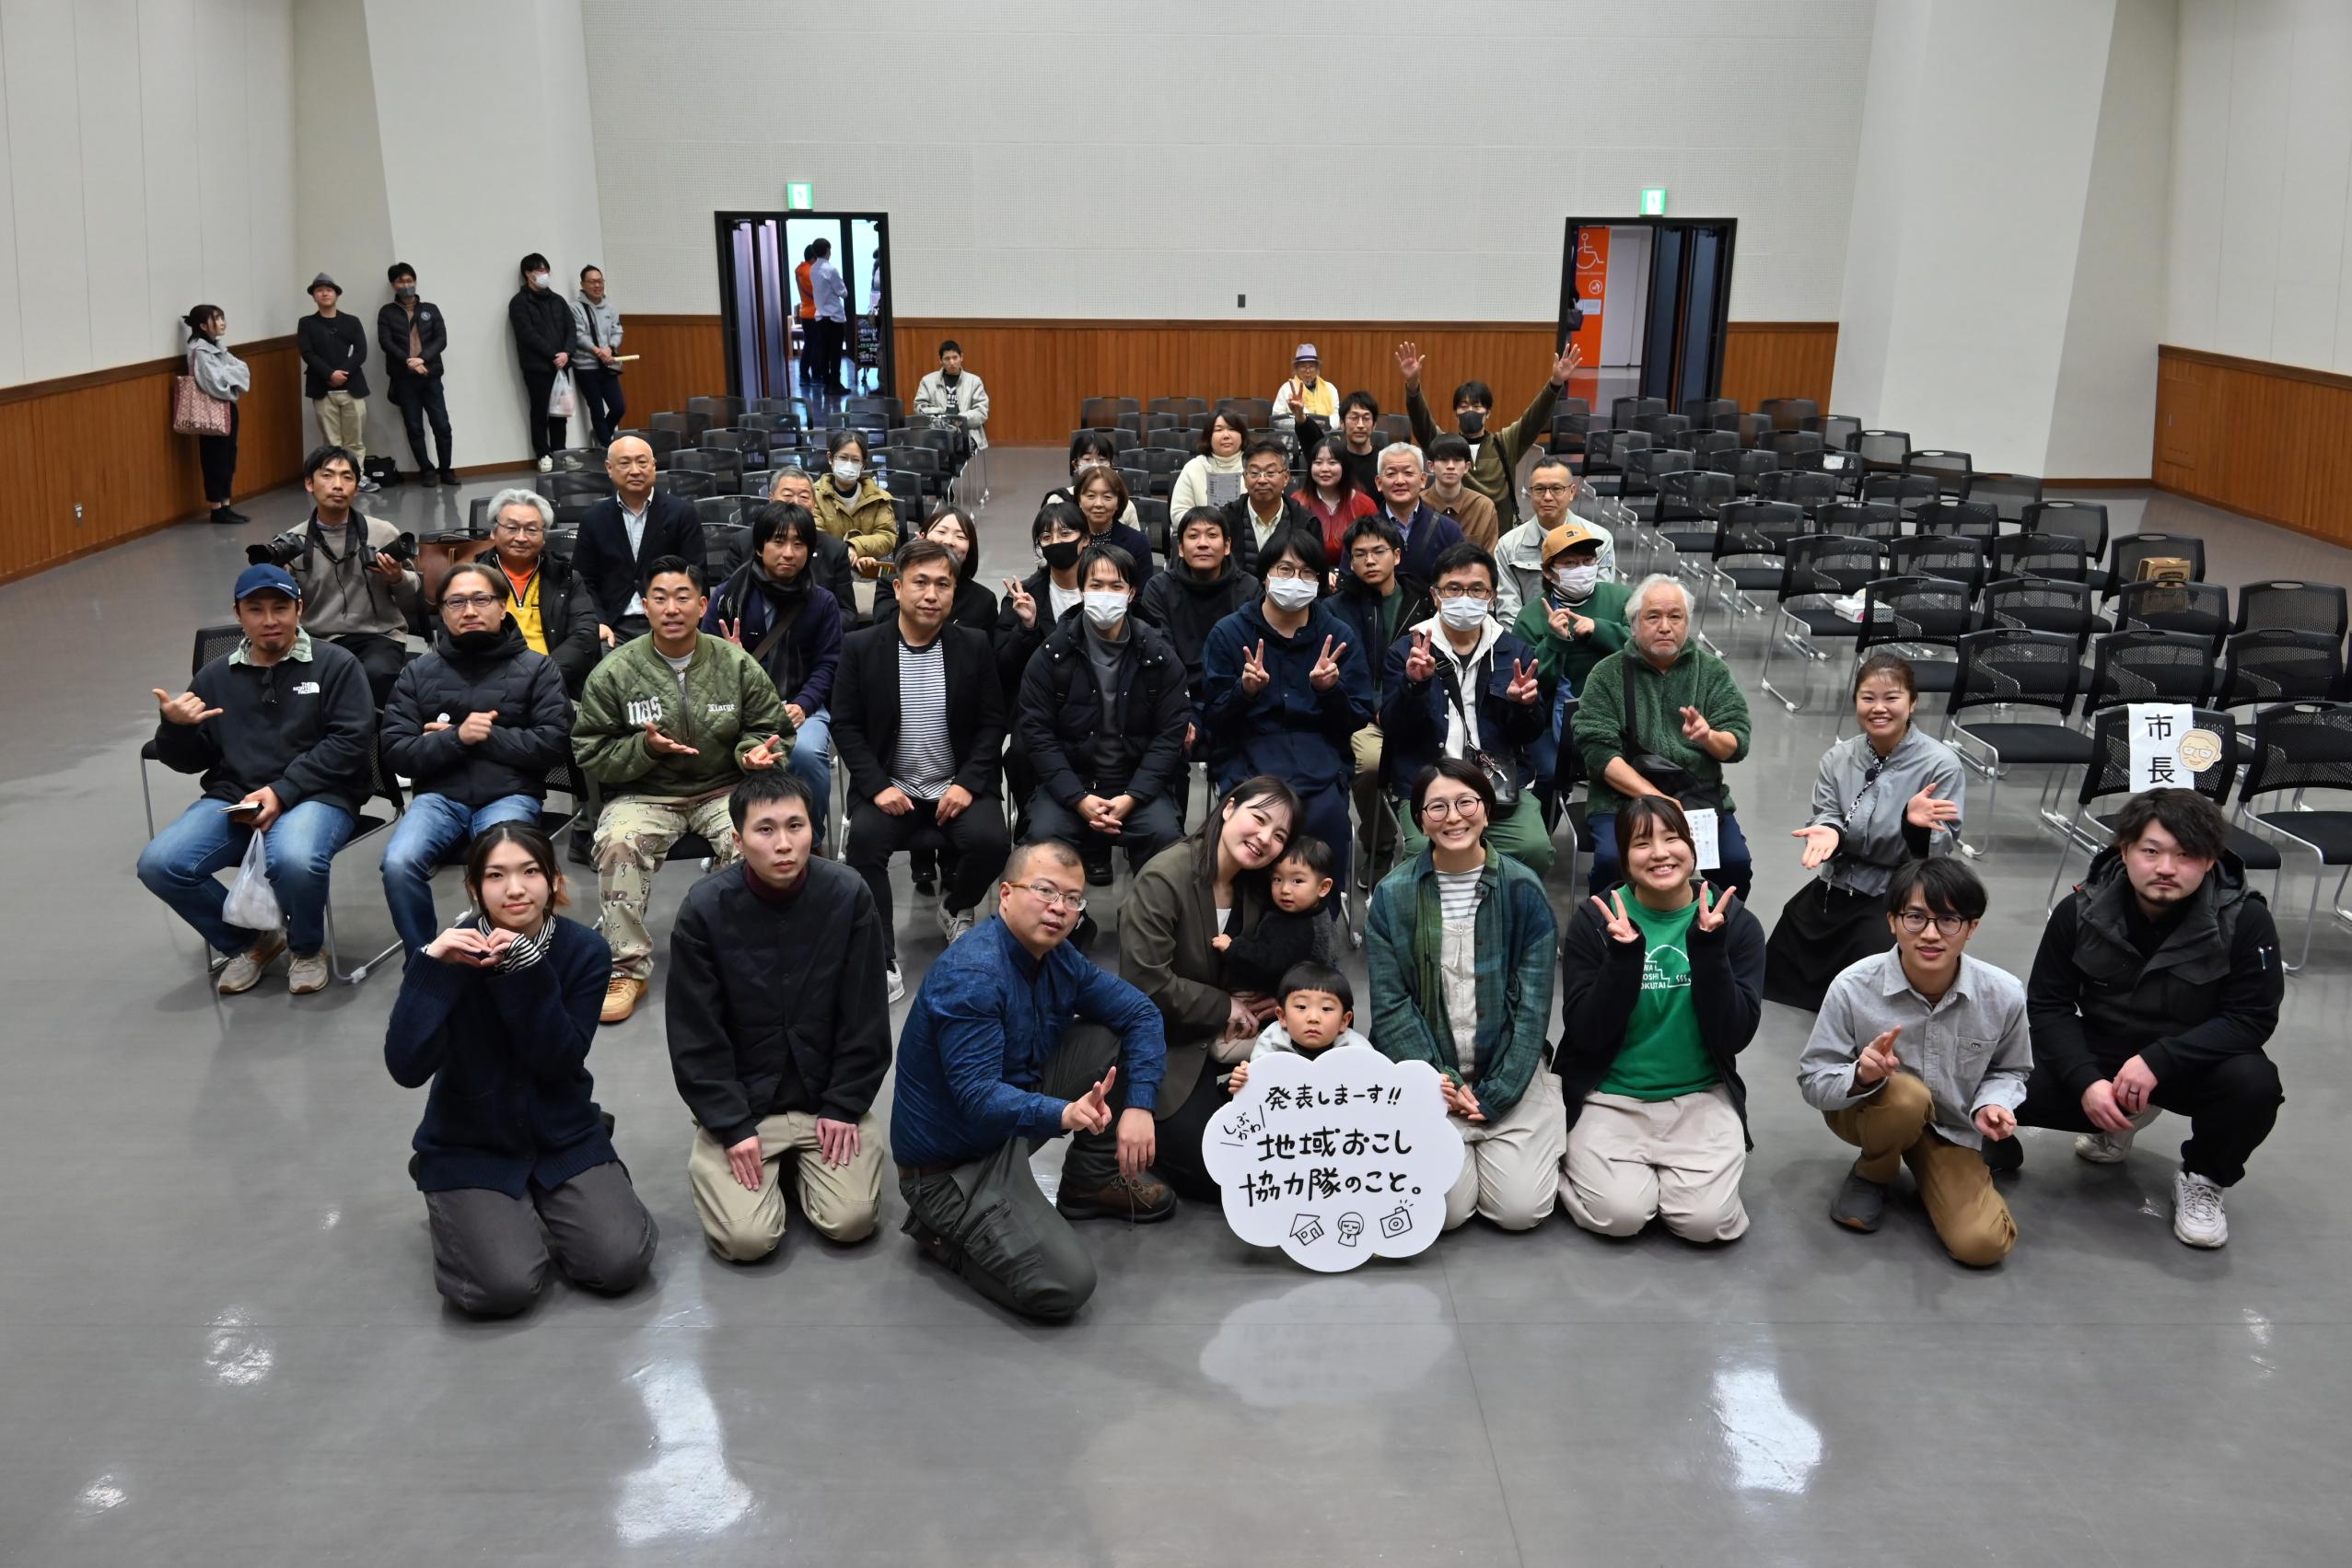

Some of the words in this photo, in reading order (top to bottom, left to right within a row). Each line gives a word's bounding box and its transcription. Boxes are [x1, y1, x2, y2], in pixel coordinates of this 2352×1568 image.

[2145, 714, 2175, 784] 市長
[1256, 1125, 1413, 1162] 地域おこし
[1239, 1167, 1422, 1207] 協力隊のこと。
